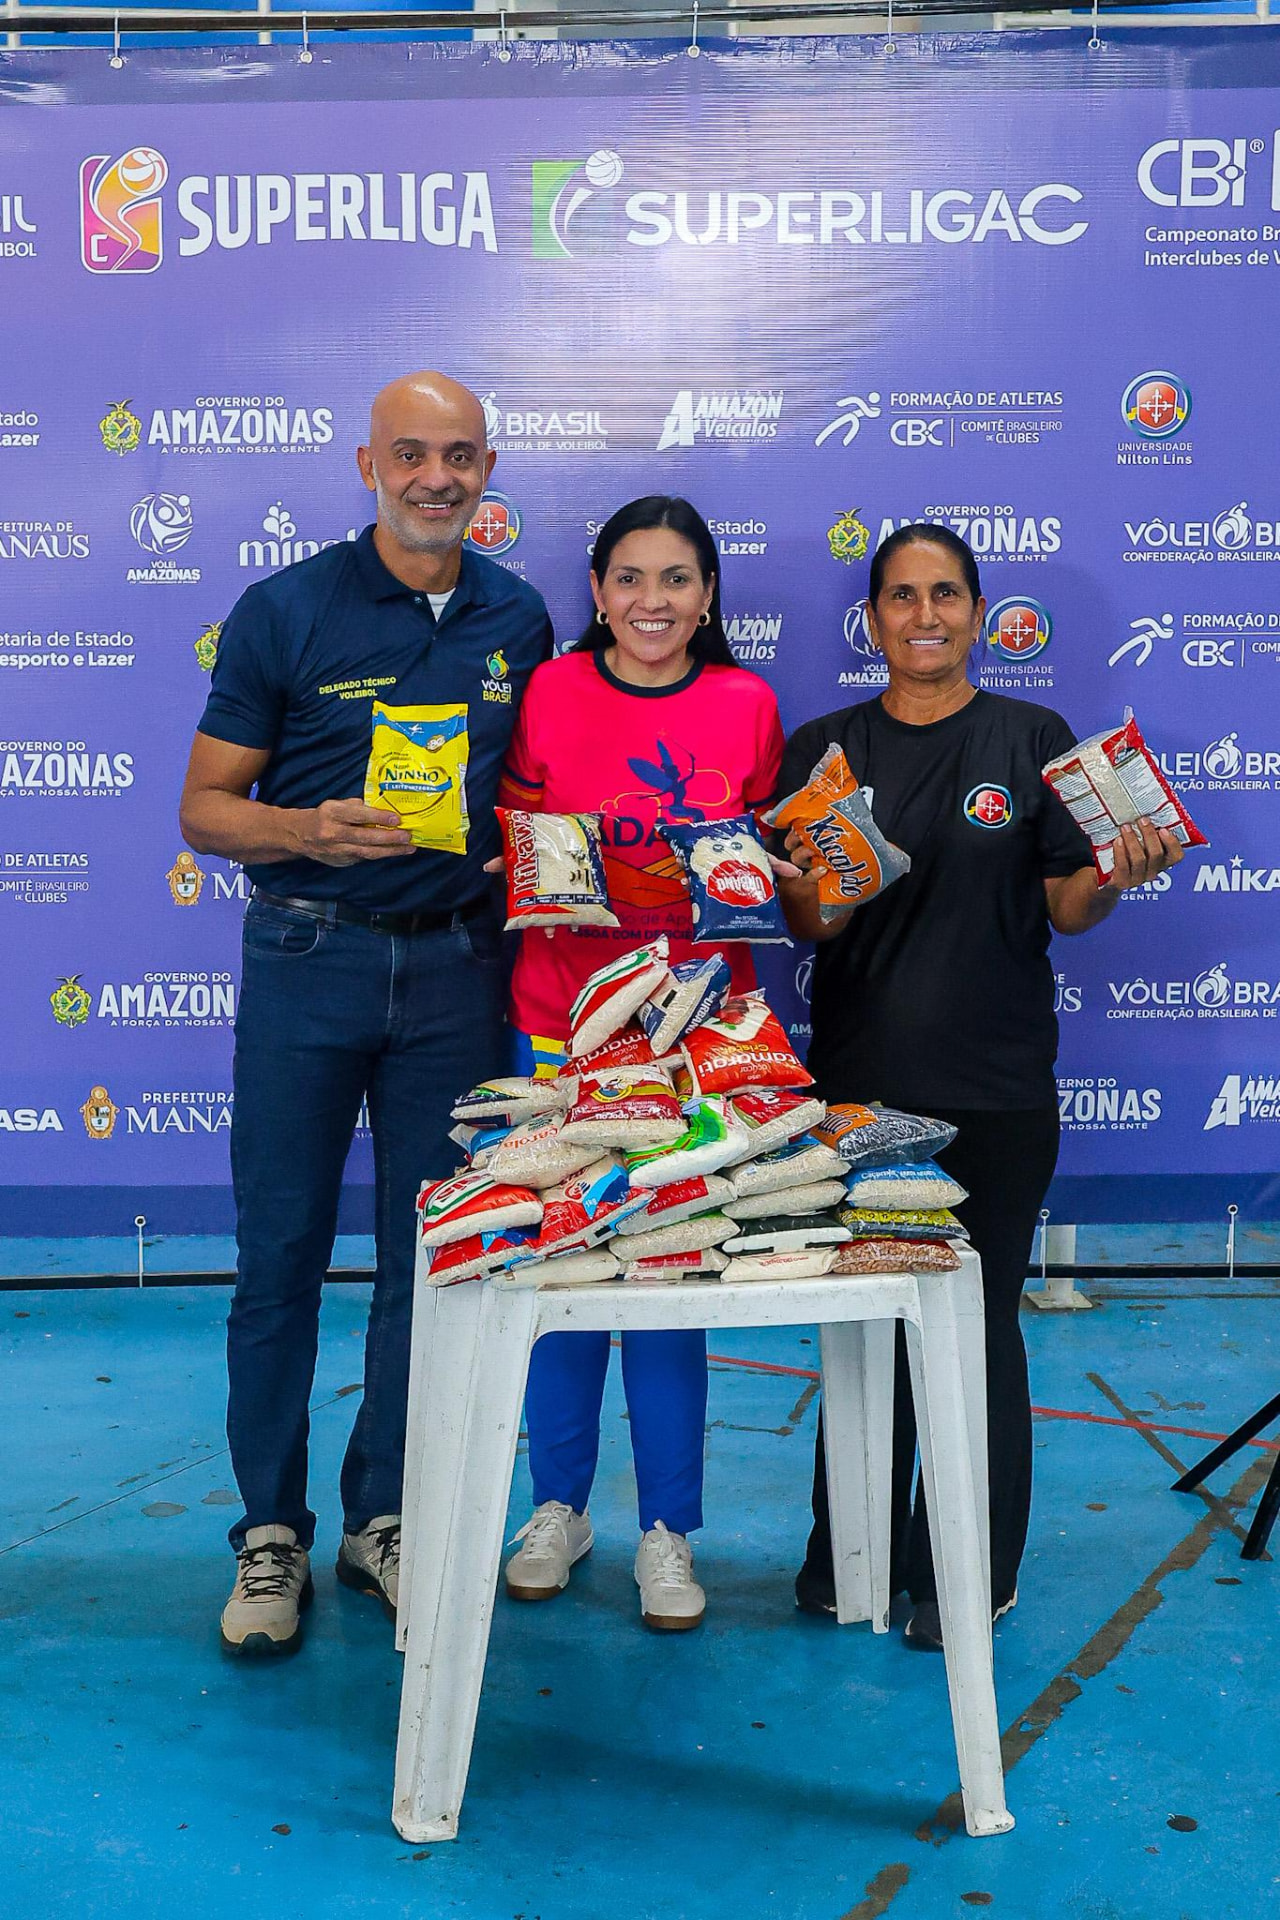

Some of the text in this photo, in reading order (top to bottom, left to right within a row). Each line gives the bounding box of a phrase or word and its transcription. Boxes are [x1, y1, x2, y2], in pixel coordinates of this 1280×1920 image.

[177, 172, 502, 257] SUPERLIGA
[1145, 226, 1258, 246] Campeonato
[1145, 249, 1242, 266] Interclubes
[1246, 249, 1269, 265] de
[195, 396, 285, 408] GOVERNO DO
[890, 390, 1063, 410] FORMAÇÃO DE ATLETAS
[693, 396, 785, 420] AMAZON
[147, 408, 334, 445] AMAZONAS
[505, 410, 609, 436] BRASIL
[704, 417, 778, 439] Veículos
[890, 418, 1063, 446] CBC COMITÊ BRASILEIRO
[995, 432, 1040, 444] CLUBES
[161, 445, 321, 455] A FORÇA DA NOSSA GENTE
[538, 441, 552, 451] DE
[557, 440, 608, 450] VOLEIBOL
[1117, 442, 1193, 452] UNIVERSIDADE
[1117, 453, 1193, 465] Nilton Lins
[924, 505, 1014, 516] GOVERNO DO
[56, 522, 73, 532] DE
[707, 518, 768, 536] Estado
[1124, 517, 1210, 547] VÔLEI
[718, 538, 769, 556] Lazer
[1008, 554, 1048, 562] GENTE
[1122, 549, 1280, 564] CONFEDERAÇÃO BRASILEIRA
[149, 559, 177, 569] VÔLEI
[125, 569, 202, 581] AMAZONAS
[1183, 612, 1265, 631] FORMAÇÃO
[46, 631, 70, 647] de
[75, 631, 134, 647] Estado
[72, 654, 85, 667] e
[88, 651, 135, 666] Lazer
[1182, 640, 1235, 667] CBC
[980, 665, 1054, 675] UNIVERSIDADE
[319, 676, 397, 694] DELEGADO TÉCNICO
[481, 679, 512, 694] VÔLEI
[979, 676, 1054, 688] Nilton Lins
[339, 688, 378, 700] VOLEIBOL
[0, 741, 86, 752] GOVERNO DO
[385, 767, 439, 783] NINHO
[1207, 780, 1271, 790] BRASILEIRA
[19, 789, 35, 797] DA
[39, 789, 79, 797] NOSSA
[82, 788, 122, 797] GENTE
[511, 808, 540, 896] Itikawa
[804, 809, 873, 898] Kicaldo
[5, 853, 89, 867] DE ATLETAS
[35, 881, 90, 892] BRASILEIRO
[24, 892, 68, 903] CLUBES
[1120, 893, 1159, 901] GENTE
[144, 972, 231, 983] GOVERNO DO
[1108, 977, 1191, 1005] VÔLEI
[1106, 1006, 1278, 1021] CONFEDERAÇÃO BRASILEIRA DE
[122, 1019, 161, 1028] FORÇA
[164, 1019, 180, 1027] DA
[1057, 1077, 1117, 1088] ERNO DO
[142, 1091, 234, 1104] PREFEITURA
[1068, 1123, 1107, 1131] NOSSA
[1110, 1122, 1148, 1130] GENTE
